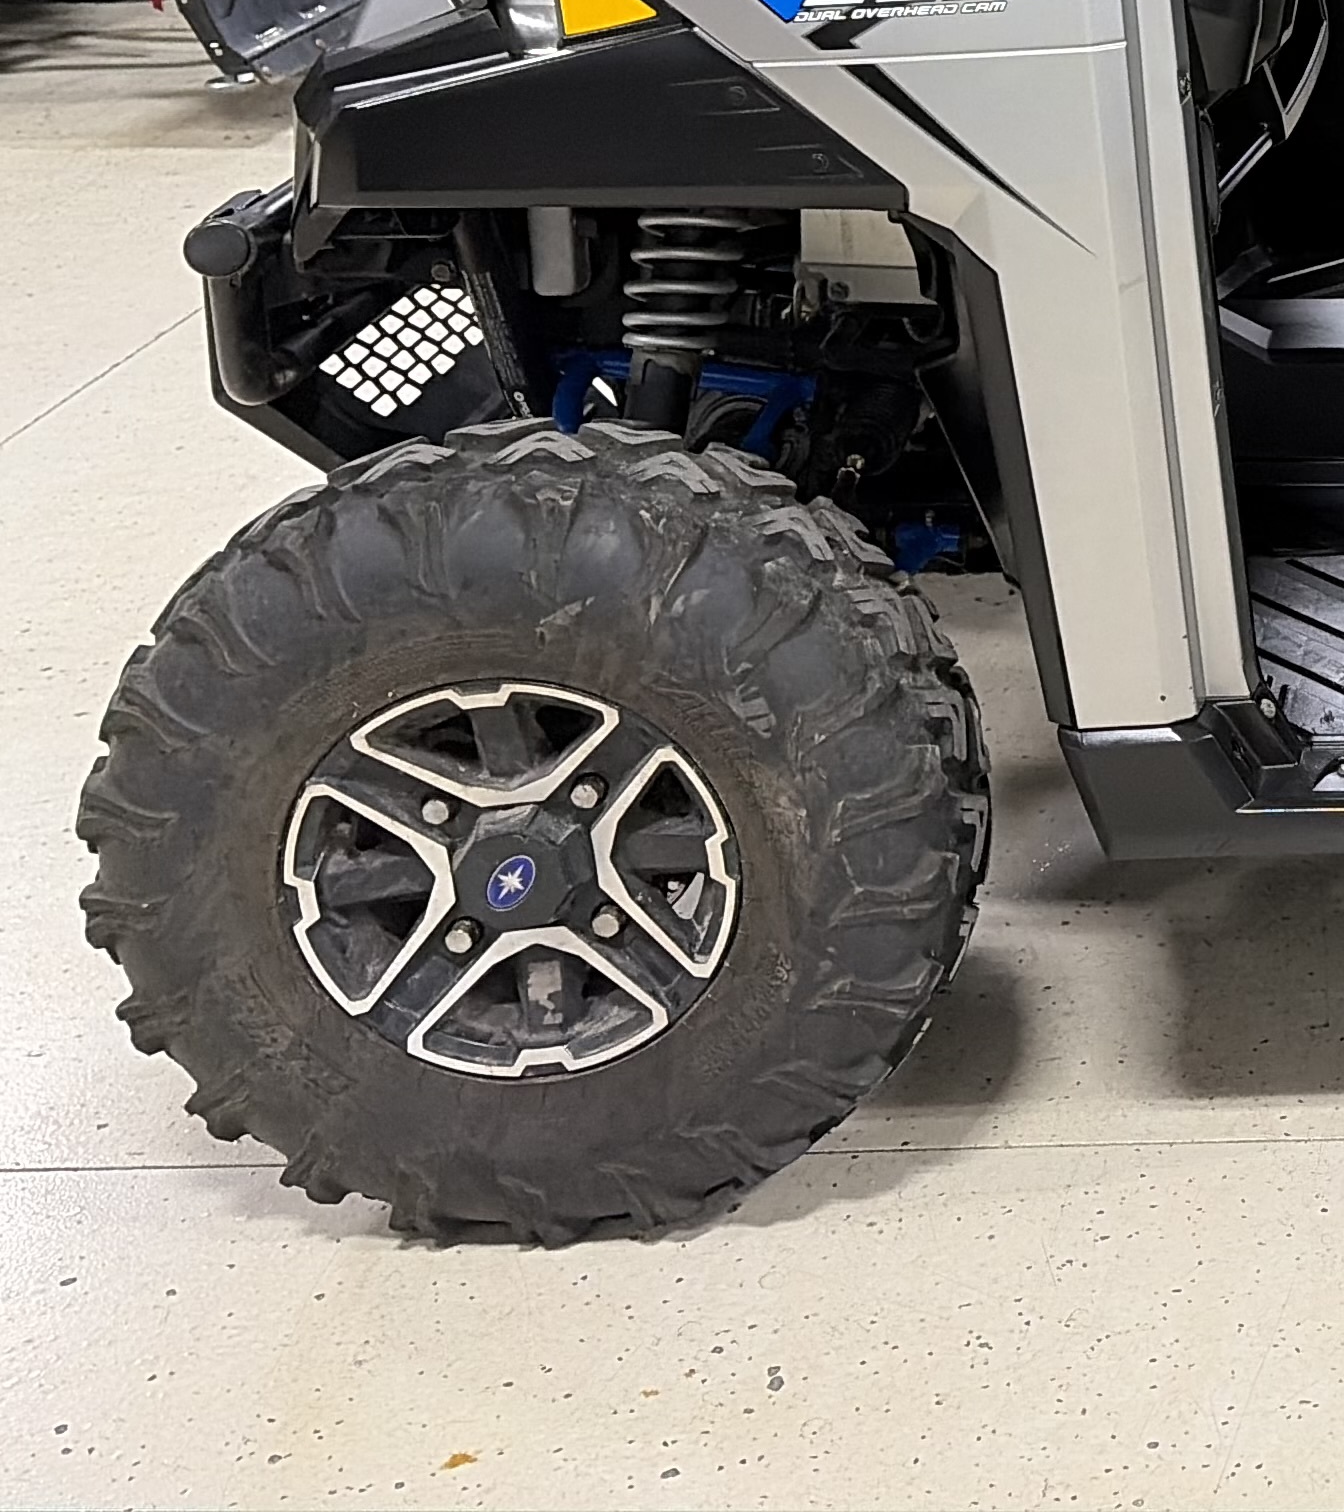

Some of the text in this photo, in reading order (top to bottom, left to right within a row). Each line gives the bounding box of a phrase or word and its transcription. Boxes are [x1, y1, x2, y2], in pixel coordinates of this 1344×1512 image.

[793, 0, 1008, 23] DUAL OVERHEAD CAM
